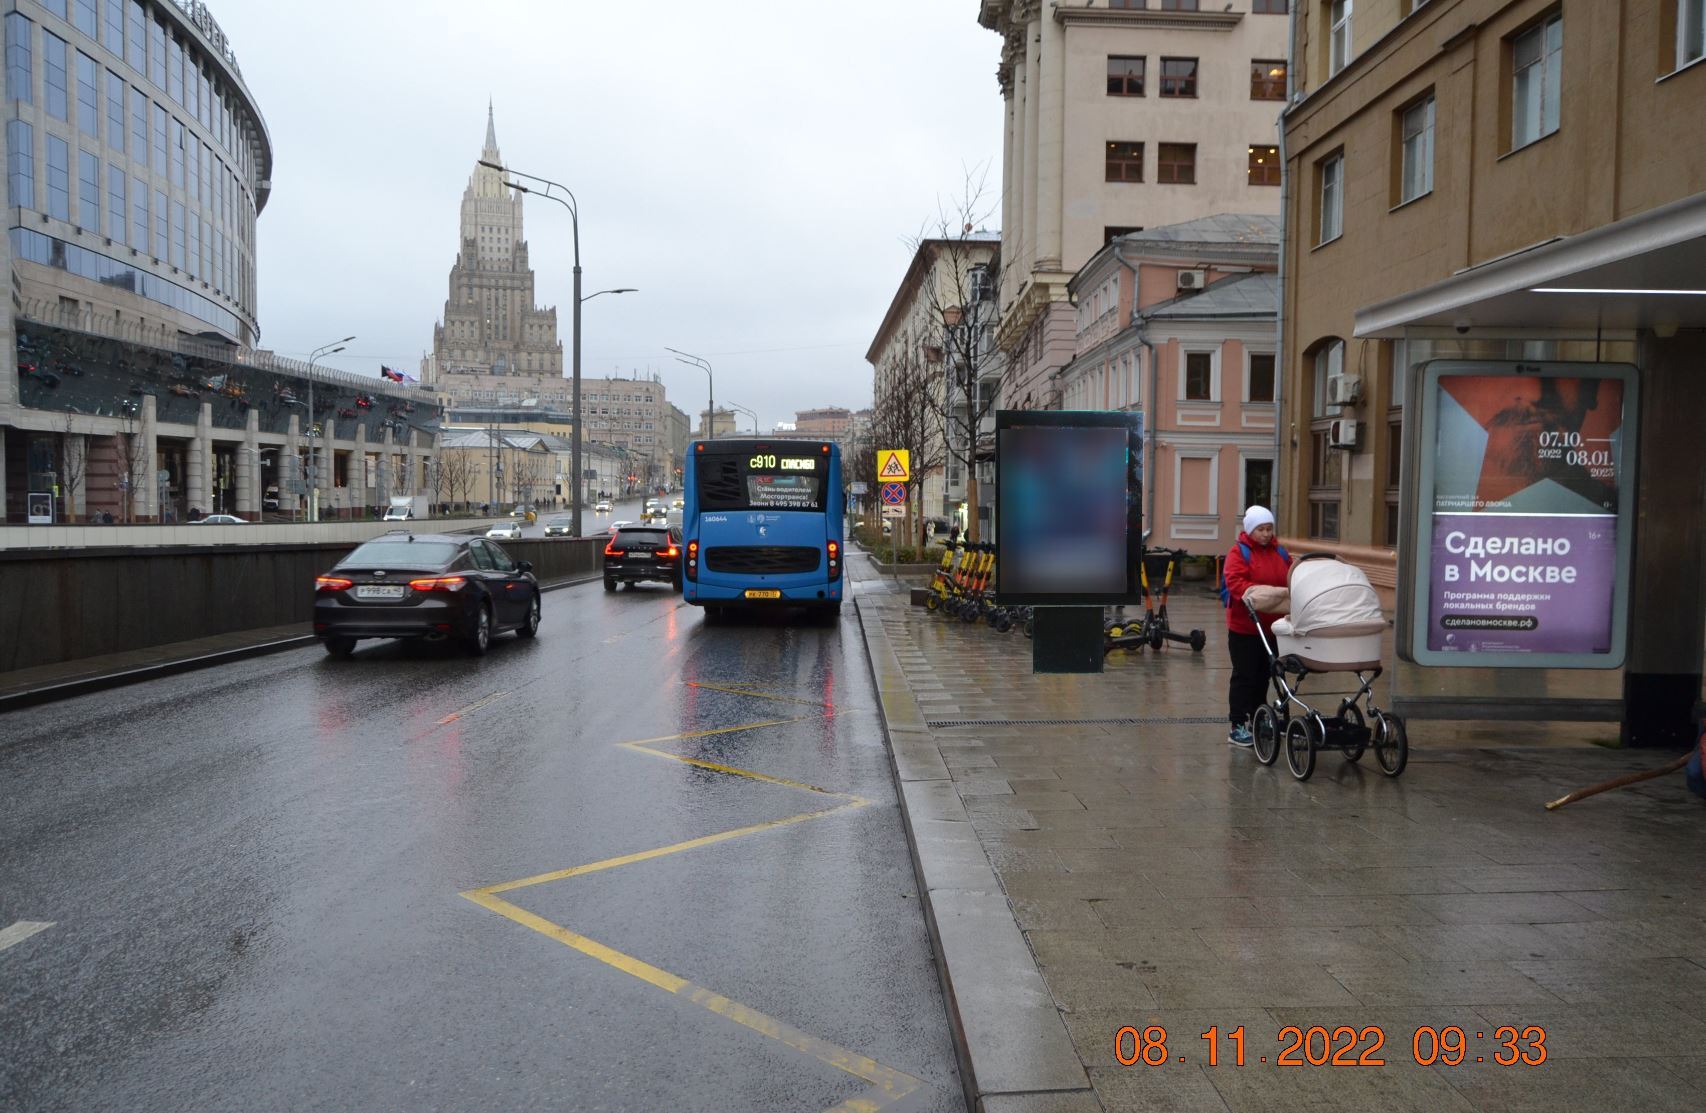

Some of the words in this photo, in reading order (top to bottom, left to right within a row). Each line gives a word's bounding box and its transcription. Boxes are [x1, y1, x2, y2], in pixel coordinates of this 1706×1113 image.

[1538, 449, 1562, 458] 2022
[1566, 450, 1615, 466] 08.01.
[1588, 531, 1601, 540] 16+
[1445, 531, 1571, 558] Сделано
[1445, 564, 1460, 582] в
[1470, 559, 1577, 583] Москве
[1443, 591, 1495, 600] Программа
[1497, 593, 1551, 601] поддержки
[1443, 601, 1493, 609] локальных
[1495, 602, 1536, 611] брендов
[1445, 618, 1533, 627] сделановмоскве.рф
